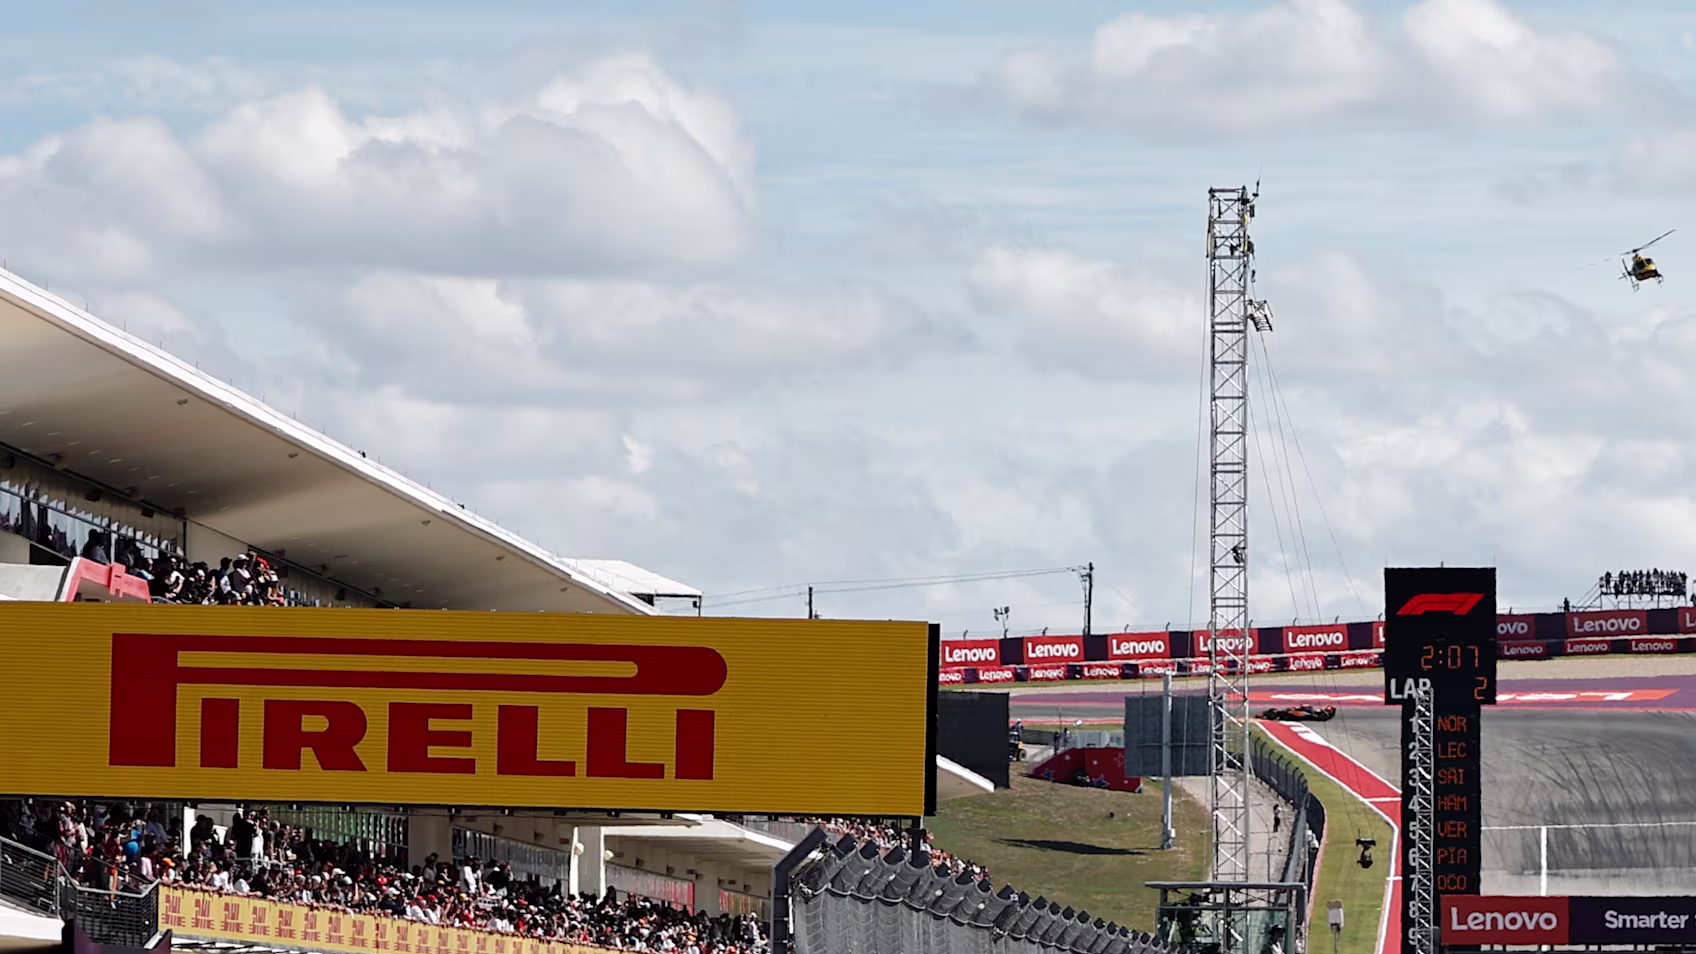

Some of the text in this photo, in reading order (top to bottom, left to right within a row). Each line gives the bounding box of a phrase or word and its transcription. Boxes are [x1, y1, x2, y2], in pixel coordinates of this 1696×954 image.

[1574, 616, 1640, 632] Lenovo
[1112, 637, 1165, 655] Lenovo
[1288, 631, 1343, 648] Lenovo
[1567, 643, 1608, 653] Lenovo
[1632, 641, 1673, 651] Lenovo
[945, 646, 996, 663] Lenovo
[1028, 641, 1079, 658] Lenovo
[1421, 645, 1479, 669] 2:07
[1504, 645, 1543, 655] Lenovo
[1289, 656, 1322, 670] Lenovo
[980, 670, 1013, 681] Lenovo
[1084, 667, 1119, 677] Lenovo
[1390, 677, 1432, 699] LAP
[1474, 676, 1487, 700] 2
[110, 633, 728, 781] PIRELLI
[1409, 715, 1467, 733] 1 NOR
[1408, 742, 1467, 760] 2 LEC
[1408, 768, 1465, 786] 3 SAI
[1408, 795, 1467, 812] 4 HAM
[1408, 821, 1467, 839] 5 VER
[1408, 848, 1467, 866] 6 PIA
[1409, 874, 1467, 891] 7 OCO
[1451, 907, 1557, 931] Lenovo
[1604, 909, 1690, 931] Smarter
